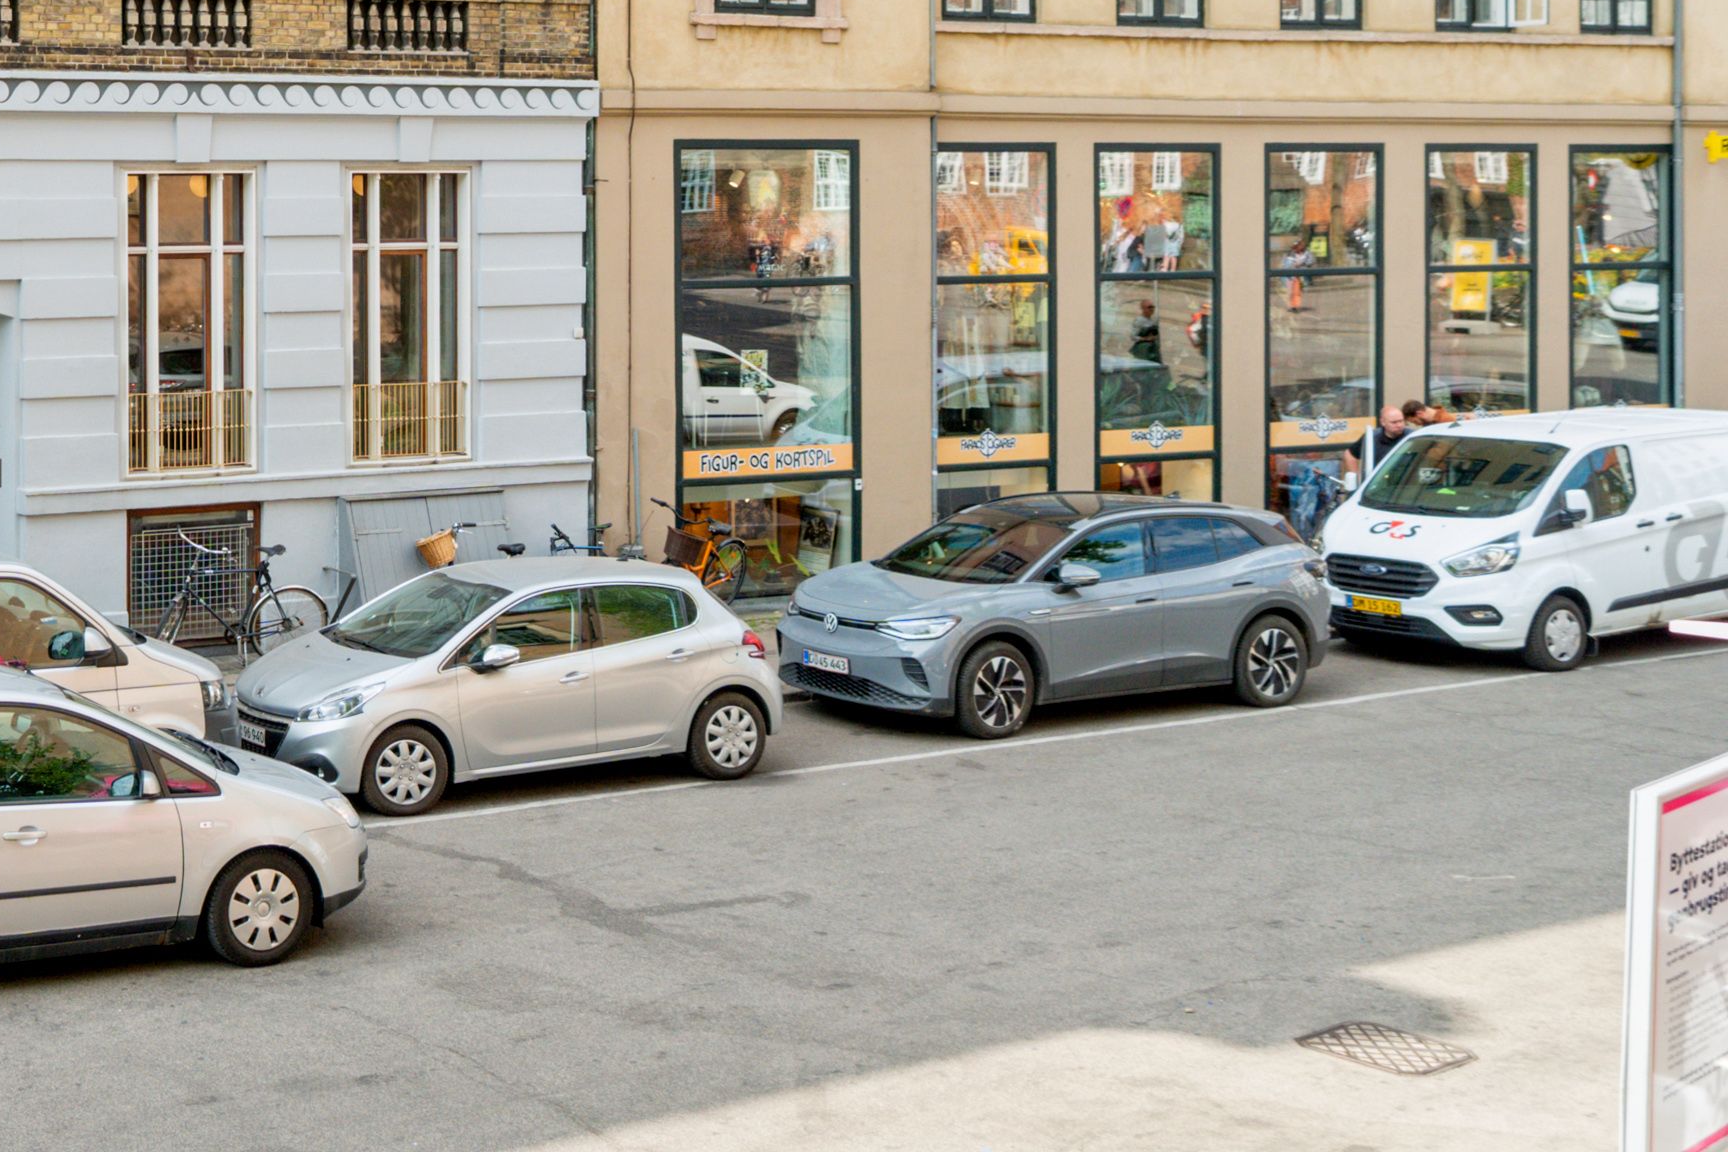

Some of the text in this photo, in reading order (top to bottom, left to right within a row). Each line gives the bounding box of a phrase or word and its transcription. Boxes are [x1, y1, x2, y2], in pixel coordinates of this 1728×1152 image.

[700, 449, 835, 472] FIGUR- OG KORTSPIL
[1370, 520, 1421, 539] G4S
[819, 657, 829, 667] 45
[830, 659, 846, 671] 443
[1682, 871, 1699, 899] giv
[1701, 867, 1714, 888] og
